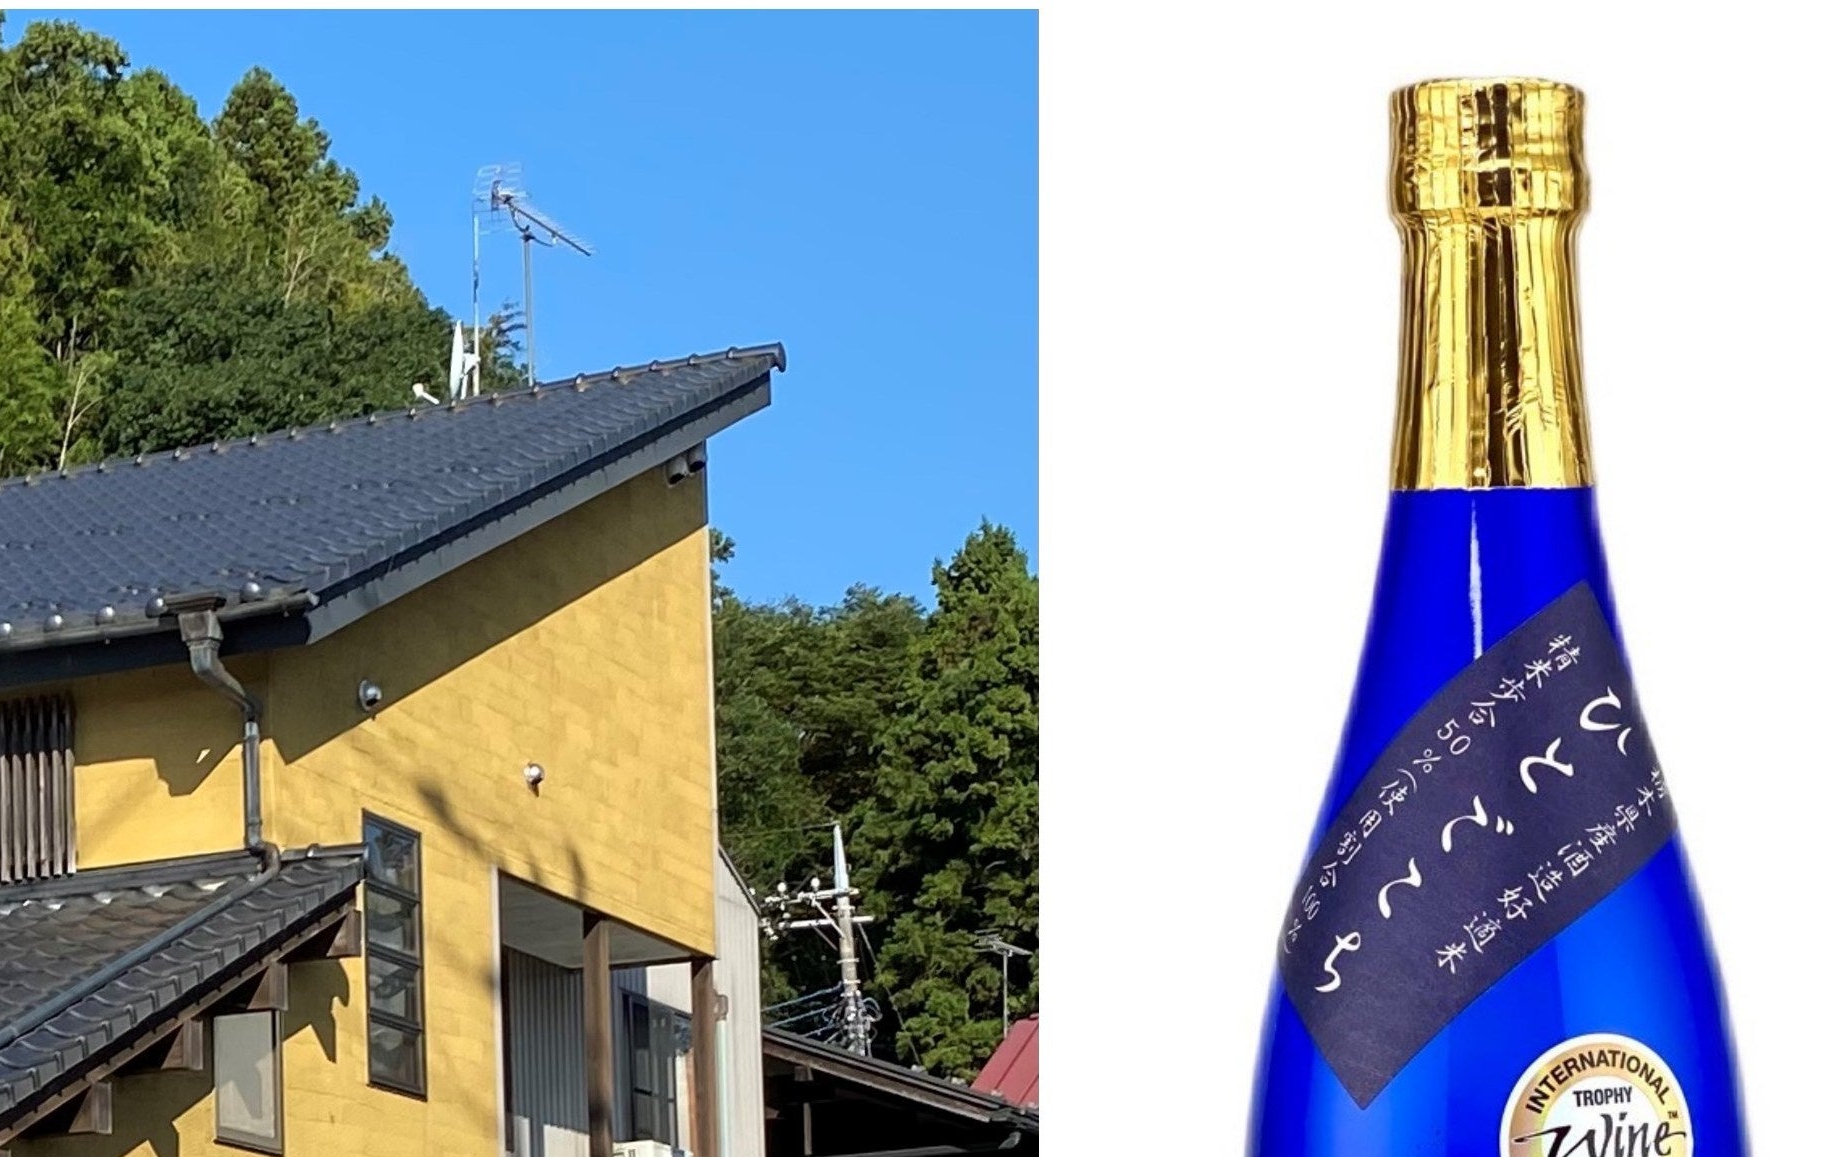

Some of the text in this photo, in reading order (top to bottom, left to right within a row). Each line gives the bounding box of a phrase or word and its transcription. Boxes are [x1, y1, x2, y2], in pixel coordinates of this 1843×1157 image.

[1314, 685, 1632, 993] ひとごこち
[1524, 1049, 1672, 1115] INTERNATIONAL
[1572, 1086, 1633, 1108] TROPHY
